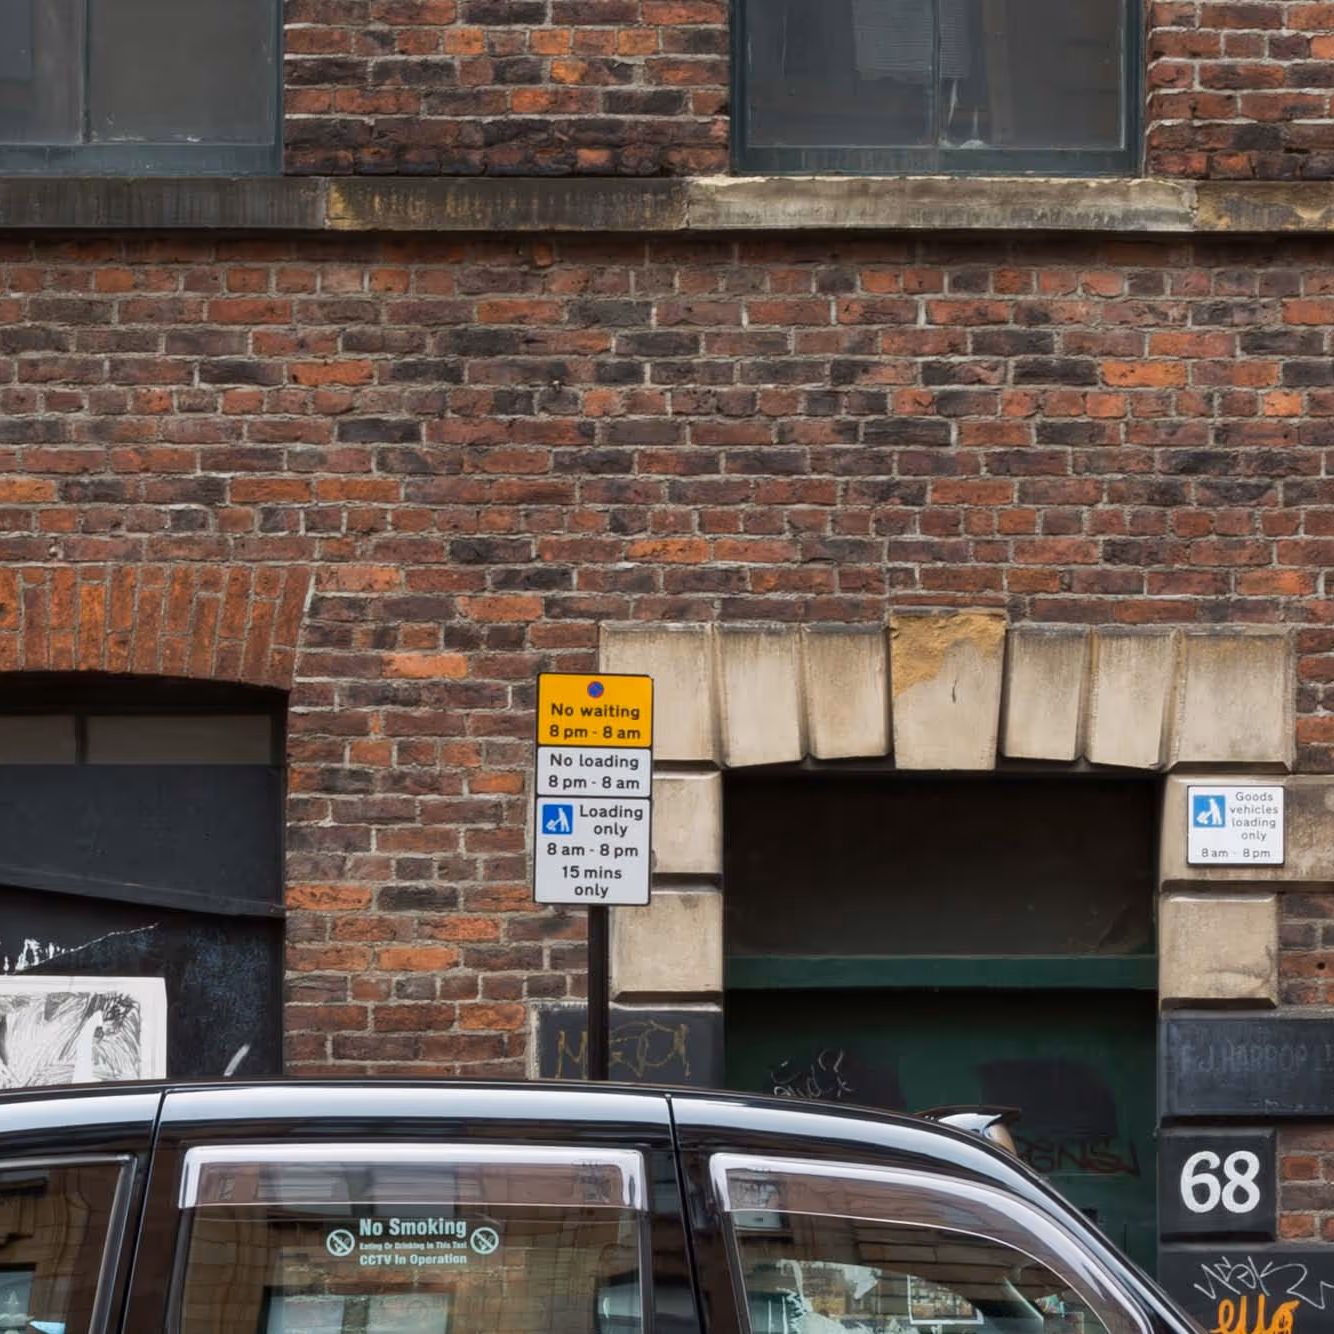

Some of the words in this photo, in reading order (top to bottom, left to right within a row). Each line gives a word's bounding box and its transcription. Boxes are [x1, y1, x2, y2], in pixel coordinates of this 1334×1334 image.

[551, 703, 574, 717] No
[580, 704, 640, 720] waiting
[549, 724, 559, 737] 8
[563, 727, 588, 740] pm
[602, 726, 612, 738] 8
[617, 728, 641, 739] am
[550, 753, 573, 767] No
[579, 754, 639, 770] loading
[548, 775, 558, 788] 8
[562, 777, 587, 790] pm
[602, 776, 612, 788] 8
[616, 779, 640, 789] am
[1235, 791, 1273, 802] Goods
[579, 804, 643, 821] Loading
[1229, 804, 1279, 815] vehicles
[593, 822, 628, 838] only
[1231, 817, 1276, 829] loading
[1241, 831, 1267, 842] only
[547, 843, 557, 856] 8
[561, 845, 585, 856] am
[599, 844, 610, 856] 8
[614, 846, 638, 859] pm
[1201, 848, 1210, 858] 8
[1211, 850, 1229, 858] am
[1242, 848, 1251, 858] 8
[1253, 850, 1271, 860] pm
[562, 865, 580, 879] 15
[584, 865, 622, 879] mins
[574, 883, 609, 898] only
[1180, 1150, 1261, 1214] 68
[359, 1218, 383, 1236] No
[388, 1217, 467, 1238] Smoking
[359, 1242, 383, 1251] Eating
[394, 1242, 425, 1250] Drinking
[435, 1241, 451, 1249] This
[452, 1241, 467, 1249] Taxi
[359, 1254, 392, 1266] CCTV
[394, 1254, 406, 1265] In
[409, 1253, 467, 1266] Operation
